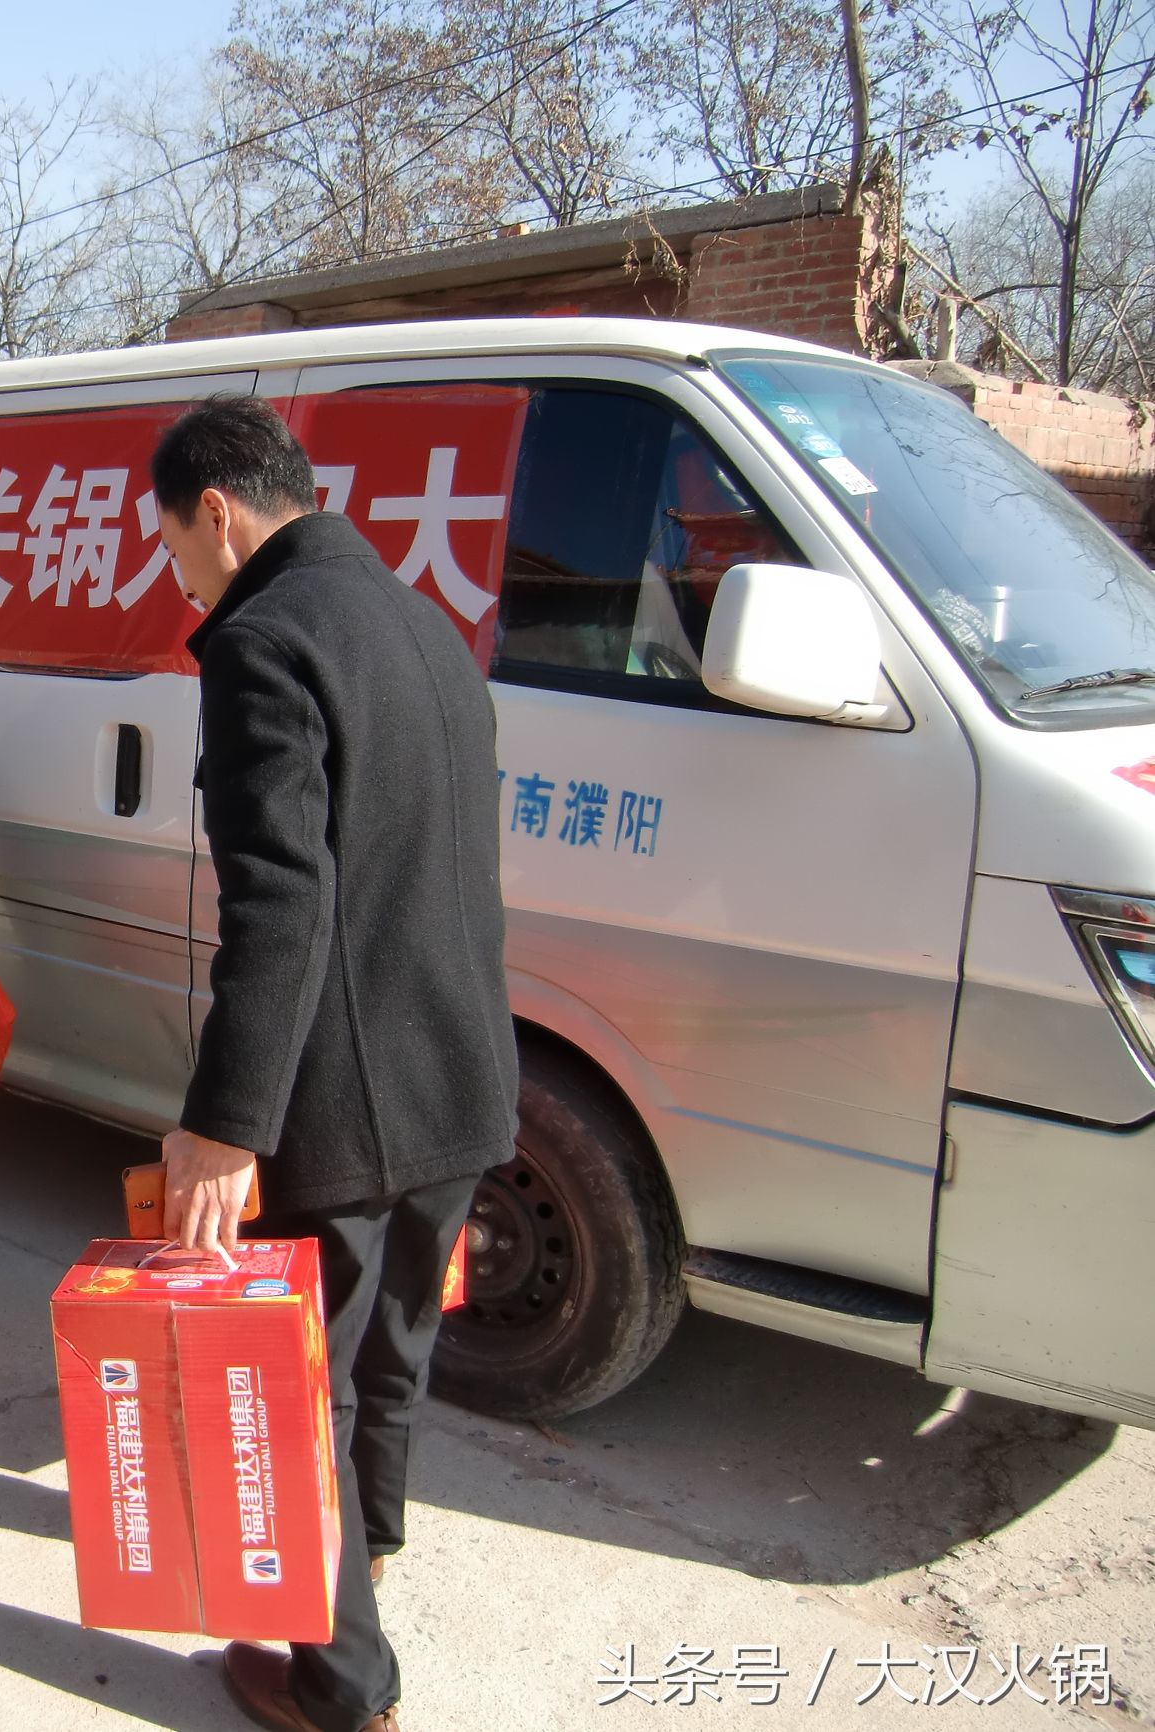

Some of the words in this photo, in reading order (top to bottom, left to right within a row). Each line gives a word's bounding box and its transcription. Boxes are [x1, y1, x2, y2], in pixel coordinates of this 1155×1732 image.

[496, 769, 662, 857] 南濮阳
[256, 1397, 269, 1439] GROUP
[106, 1424, 118, 1467] FUJIAN
[226, 1366, 267, 1545] 福建达利集团
[259, 1441, 273, 1470] DALI
[109, 1469, 120, 1497] DALI
[115, 1396, 152, 1572] 福建达利集团
[262, 1472, 276, 1516] FUJIAN
[112, 1500, 124, 1541] GROUP
